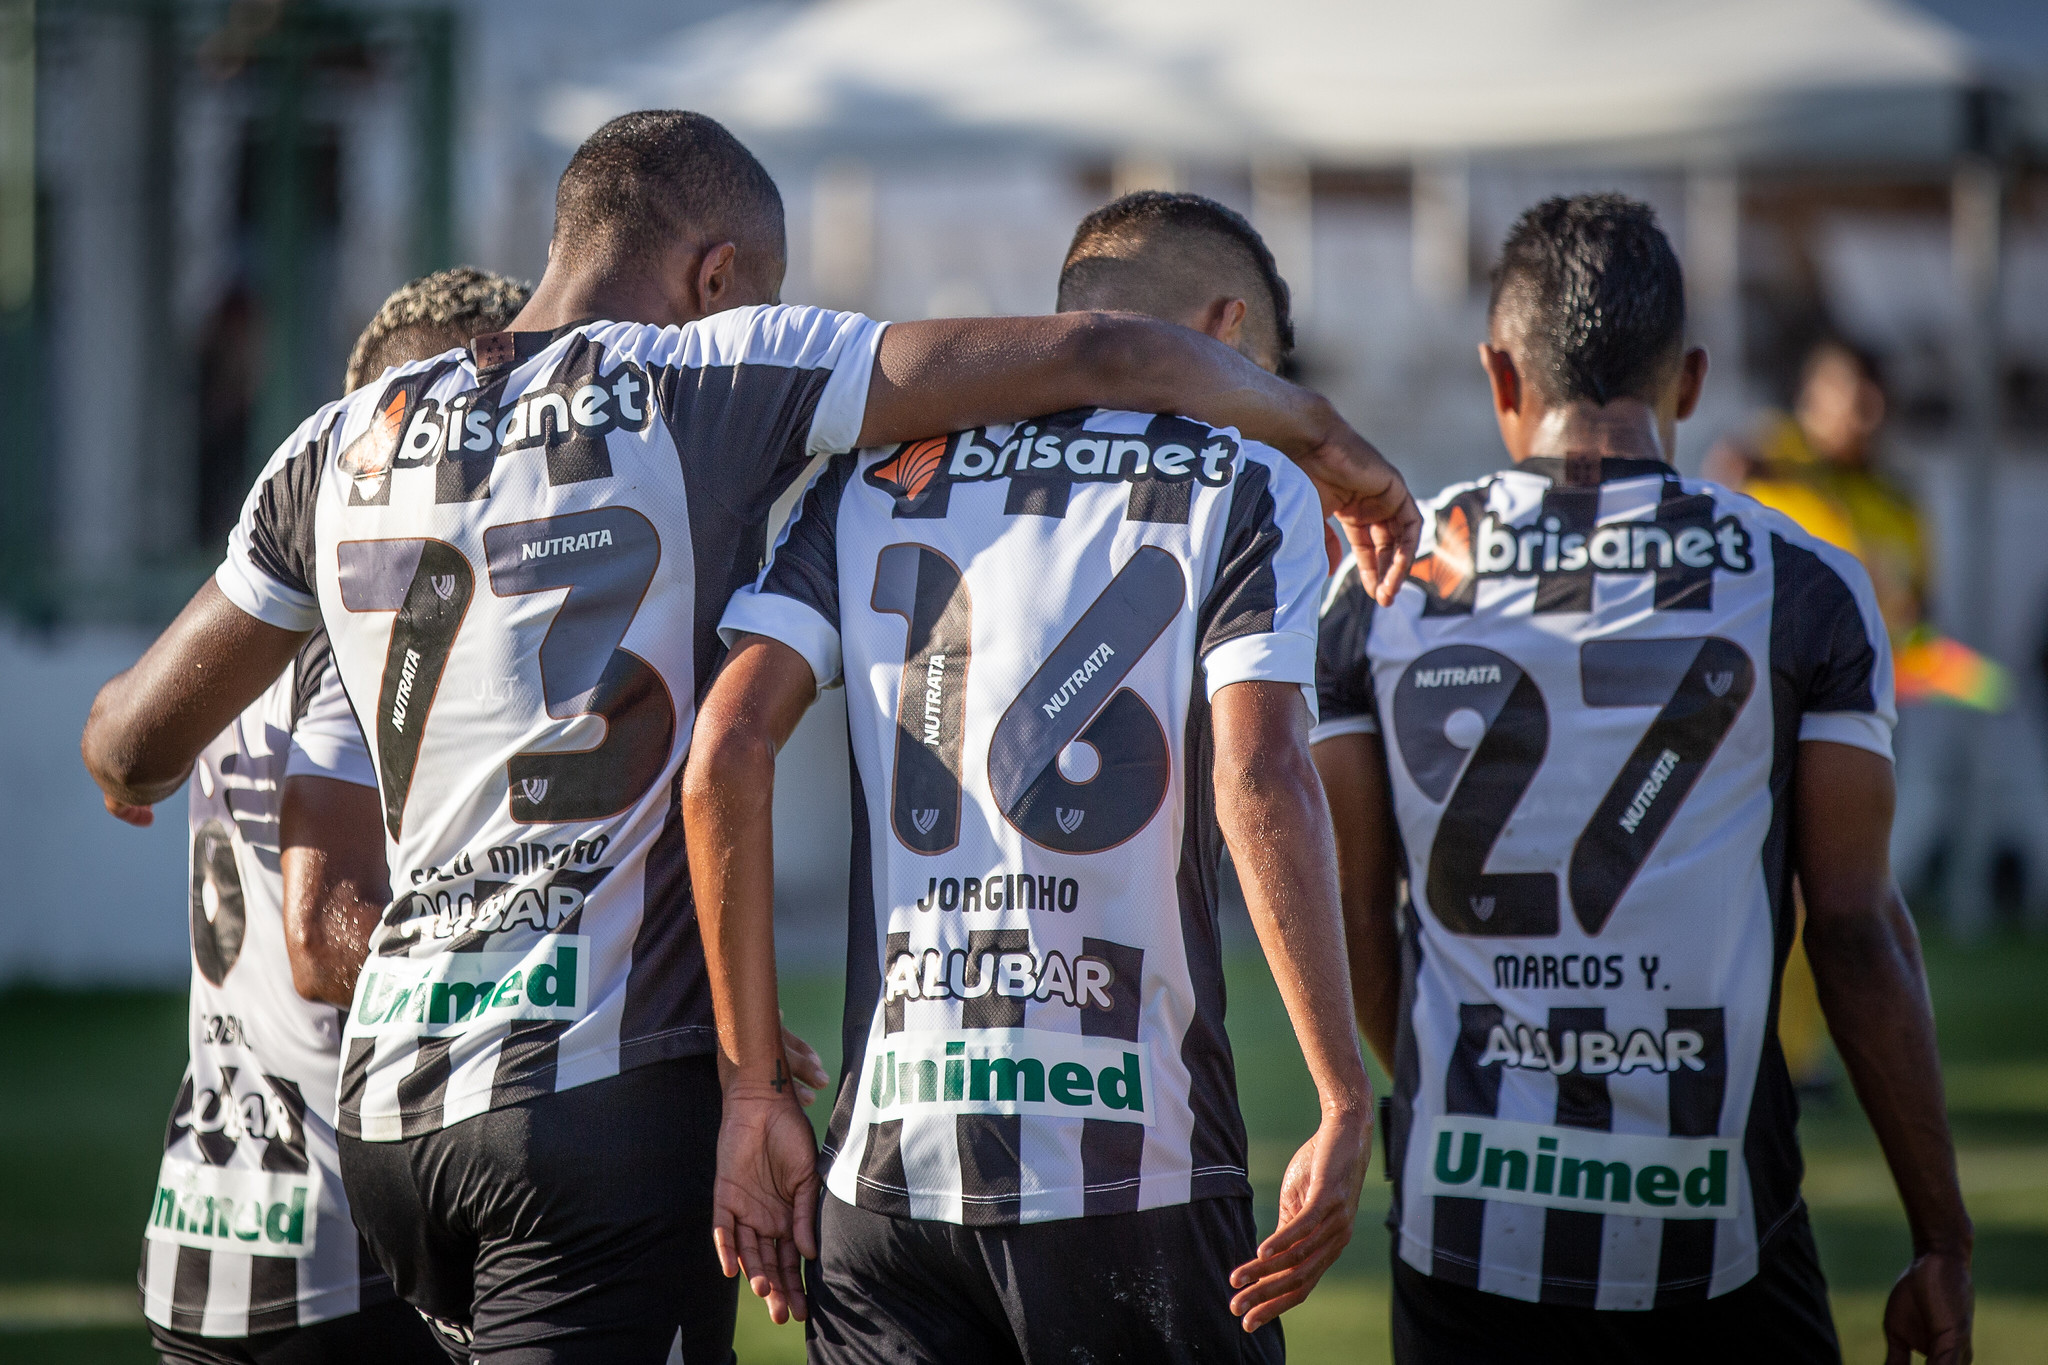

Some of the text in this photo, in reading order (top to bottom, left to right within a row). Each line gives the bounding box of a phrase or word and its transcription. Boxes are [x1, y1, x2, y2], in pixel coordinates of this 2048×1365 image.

[398, 371, 643, 461] bisanet
[947, 426, 1230, 480] brisanet
[521, 529, 613, 560] NUTRATA
[1476, 516, 1747, 573] brisanet
[337, 505, 676, 845] 73
[391, 648, 421, 733] NUTRATA
[870, 542, 1186, 856] 16
[923, 654, 946, 746] NUTRATA
[1042, 642, 1115, 719] NUTRATA
[1414, 664, 1502, 689] NUTRATA
[1393, 636, 1756, 938] 27
[1618, 748, 1681, 834] NUTRATA
[917, 874, 1080, 914] JORGINHO
[885, 951, 1112, 1009] ALUBAR
[1493, 955, 1672, 990] MARCOS Y.
[869, 1041, 1145, 1113] Unimed
[1477, 1024, 1706, 1075] ALUBAR
[1433, 1131, 1729, 1208] Unimed
